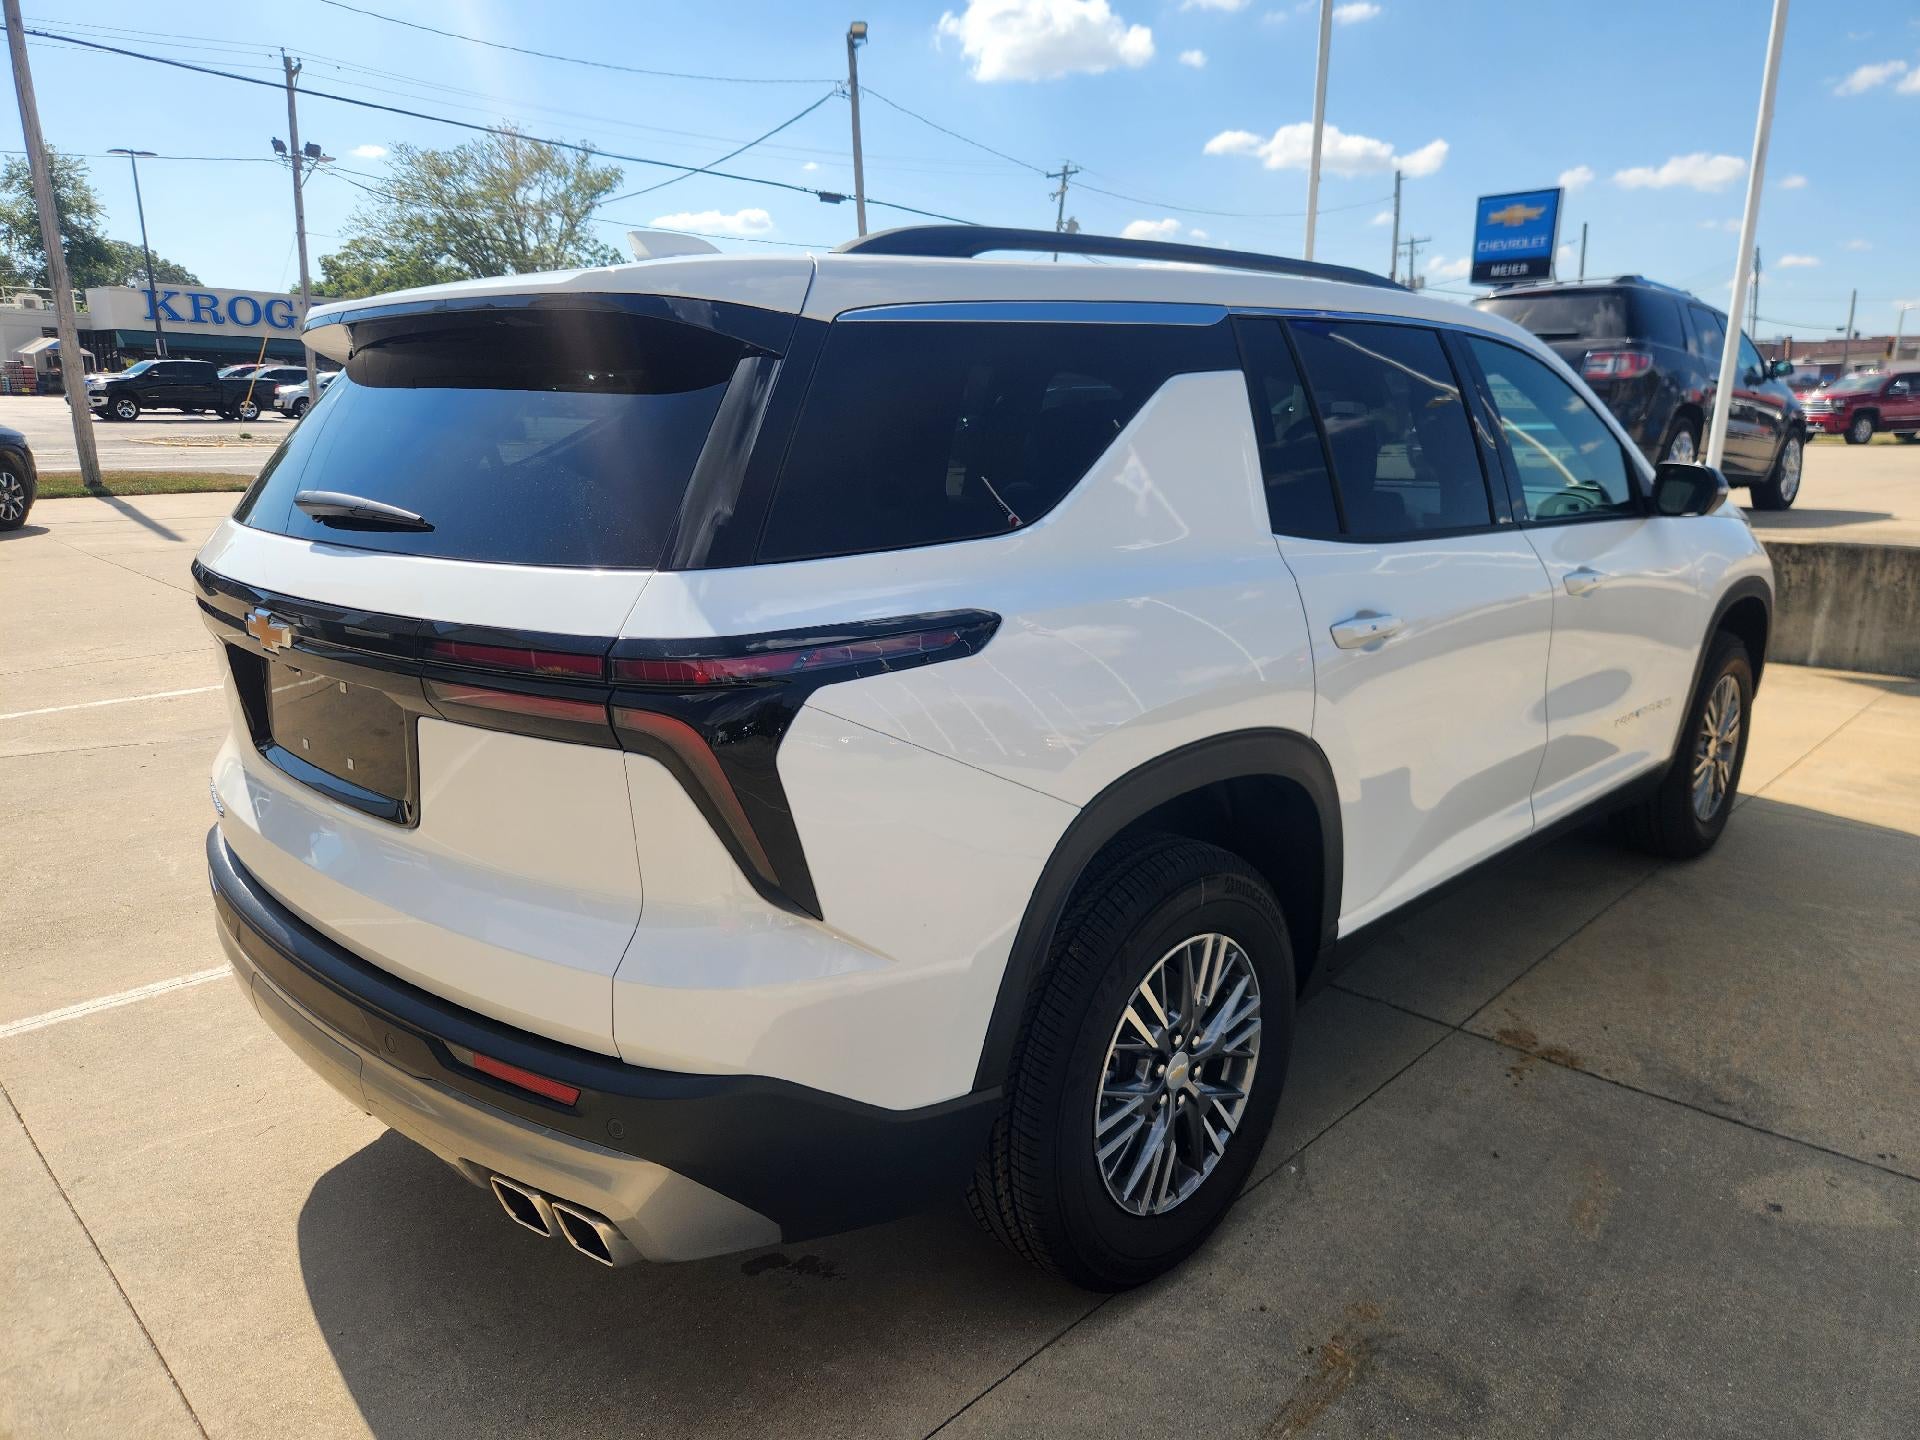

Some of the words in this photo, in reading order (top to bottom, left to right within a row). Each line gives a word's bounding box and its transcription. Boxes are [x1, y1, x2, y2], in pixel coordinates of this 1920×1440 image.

[1479, 235, 1547, 252] CHEVROLET
[1490, 263, 1528, 277] MEIER
[141, 289, 321, 329] KROG
